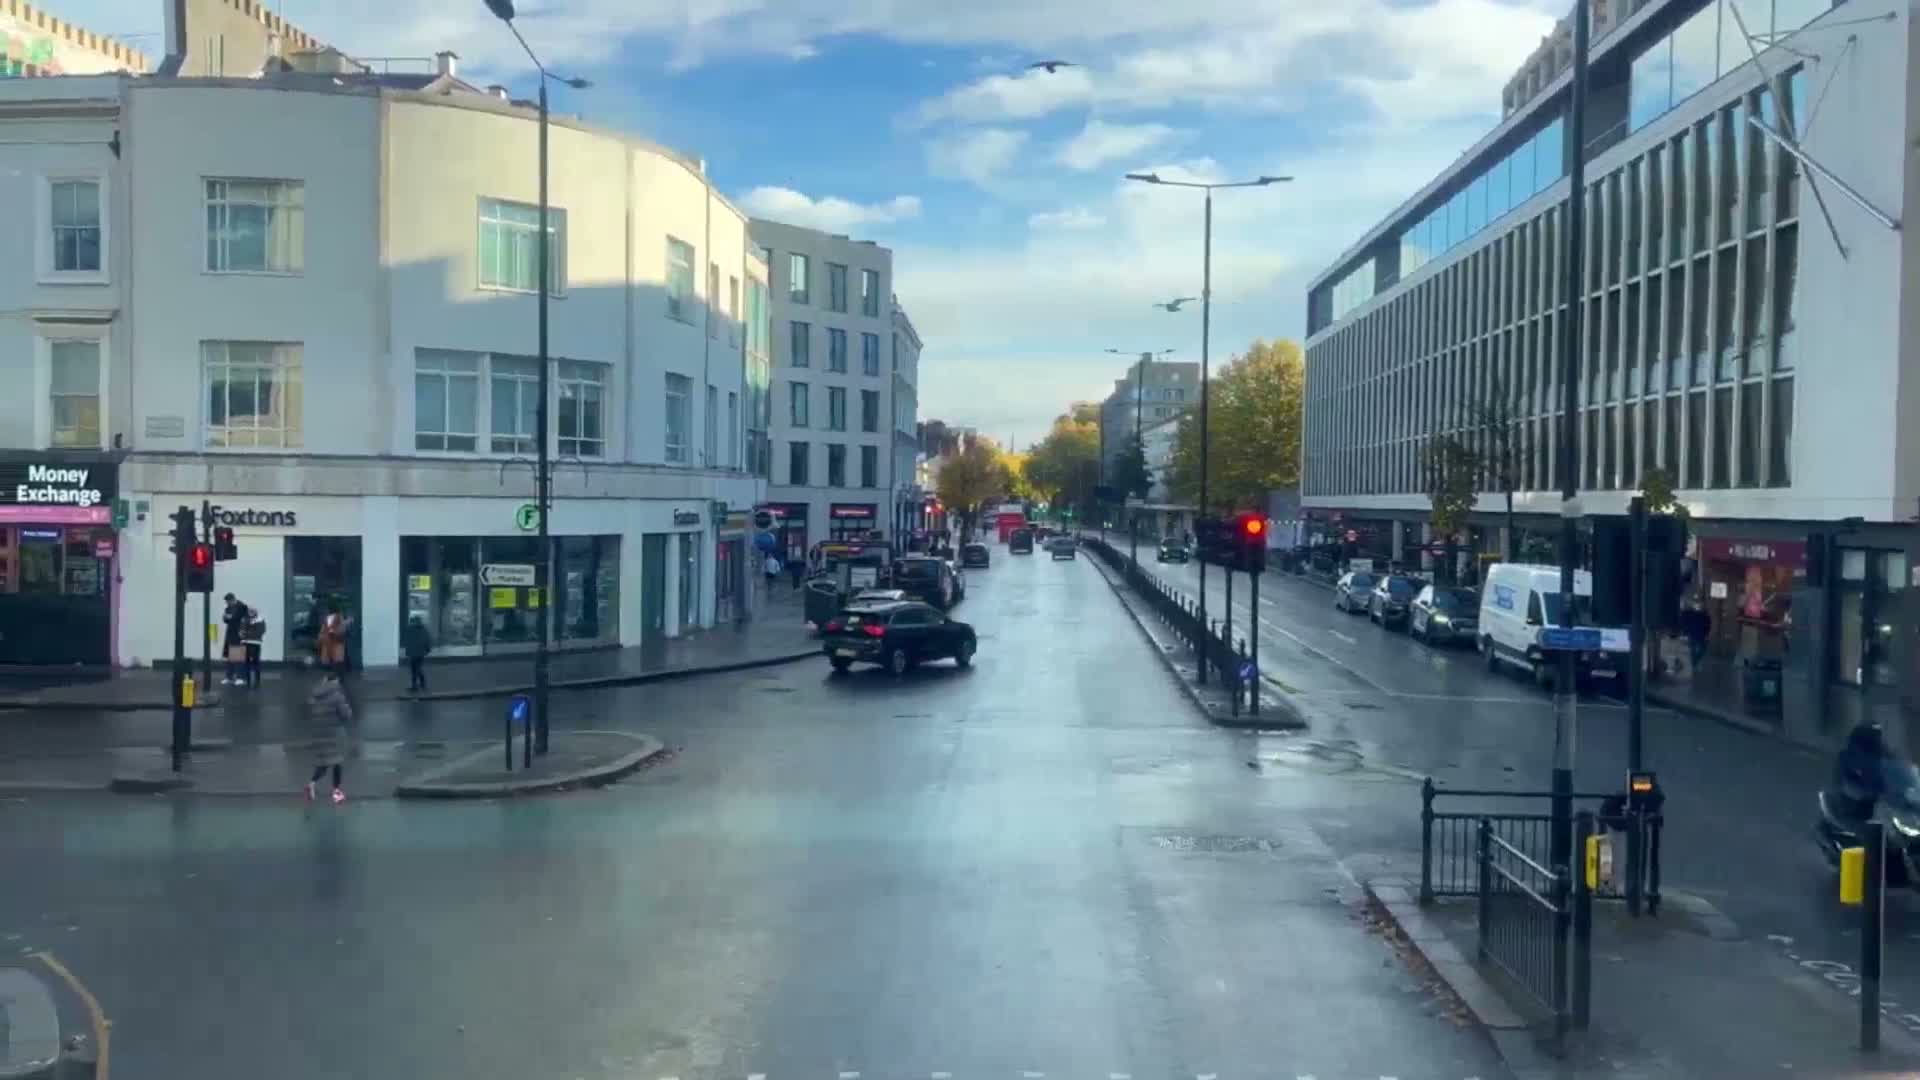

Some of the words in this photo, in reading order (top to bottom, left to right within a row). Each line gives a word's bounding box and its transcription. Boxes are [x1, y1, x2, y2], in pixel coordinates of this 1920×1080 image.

[29, 464, 88, 487] Money
[17, 484, 101, 507] Exchange
[211, 505, 297, 526] Foxtons
[525, 510, 535, 525] F
